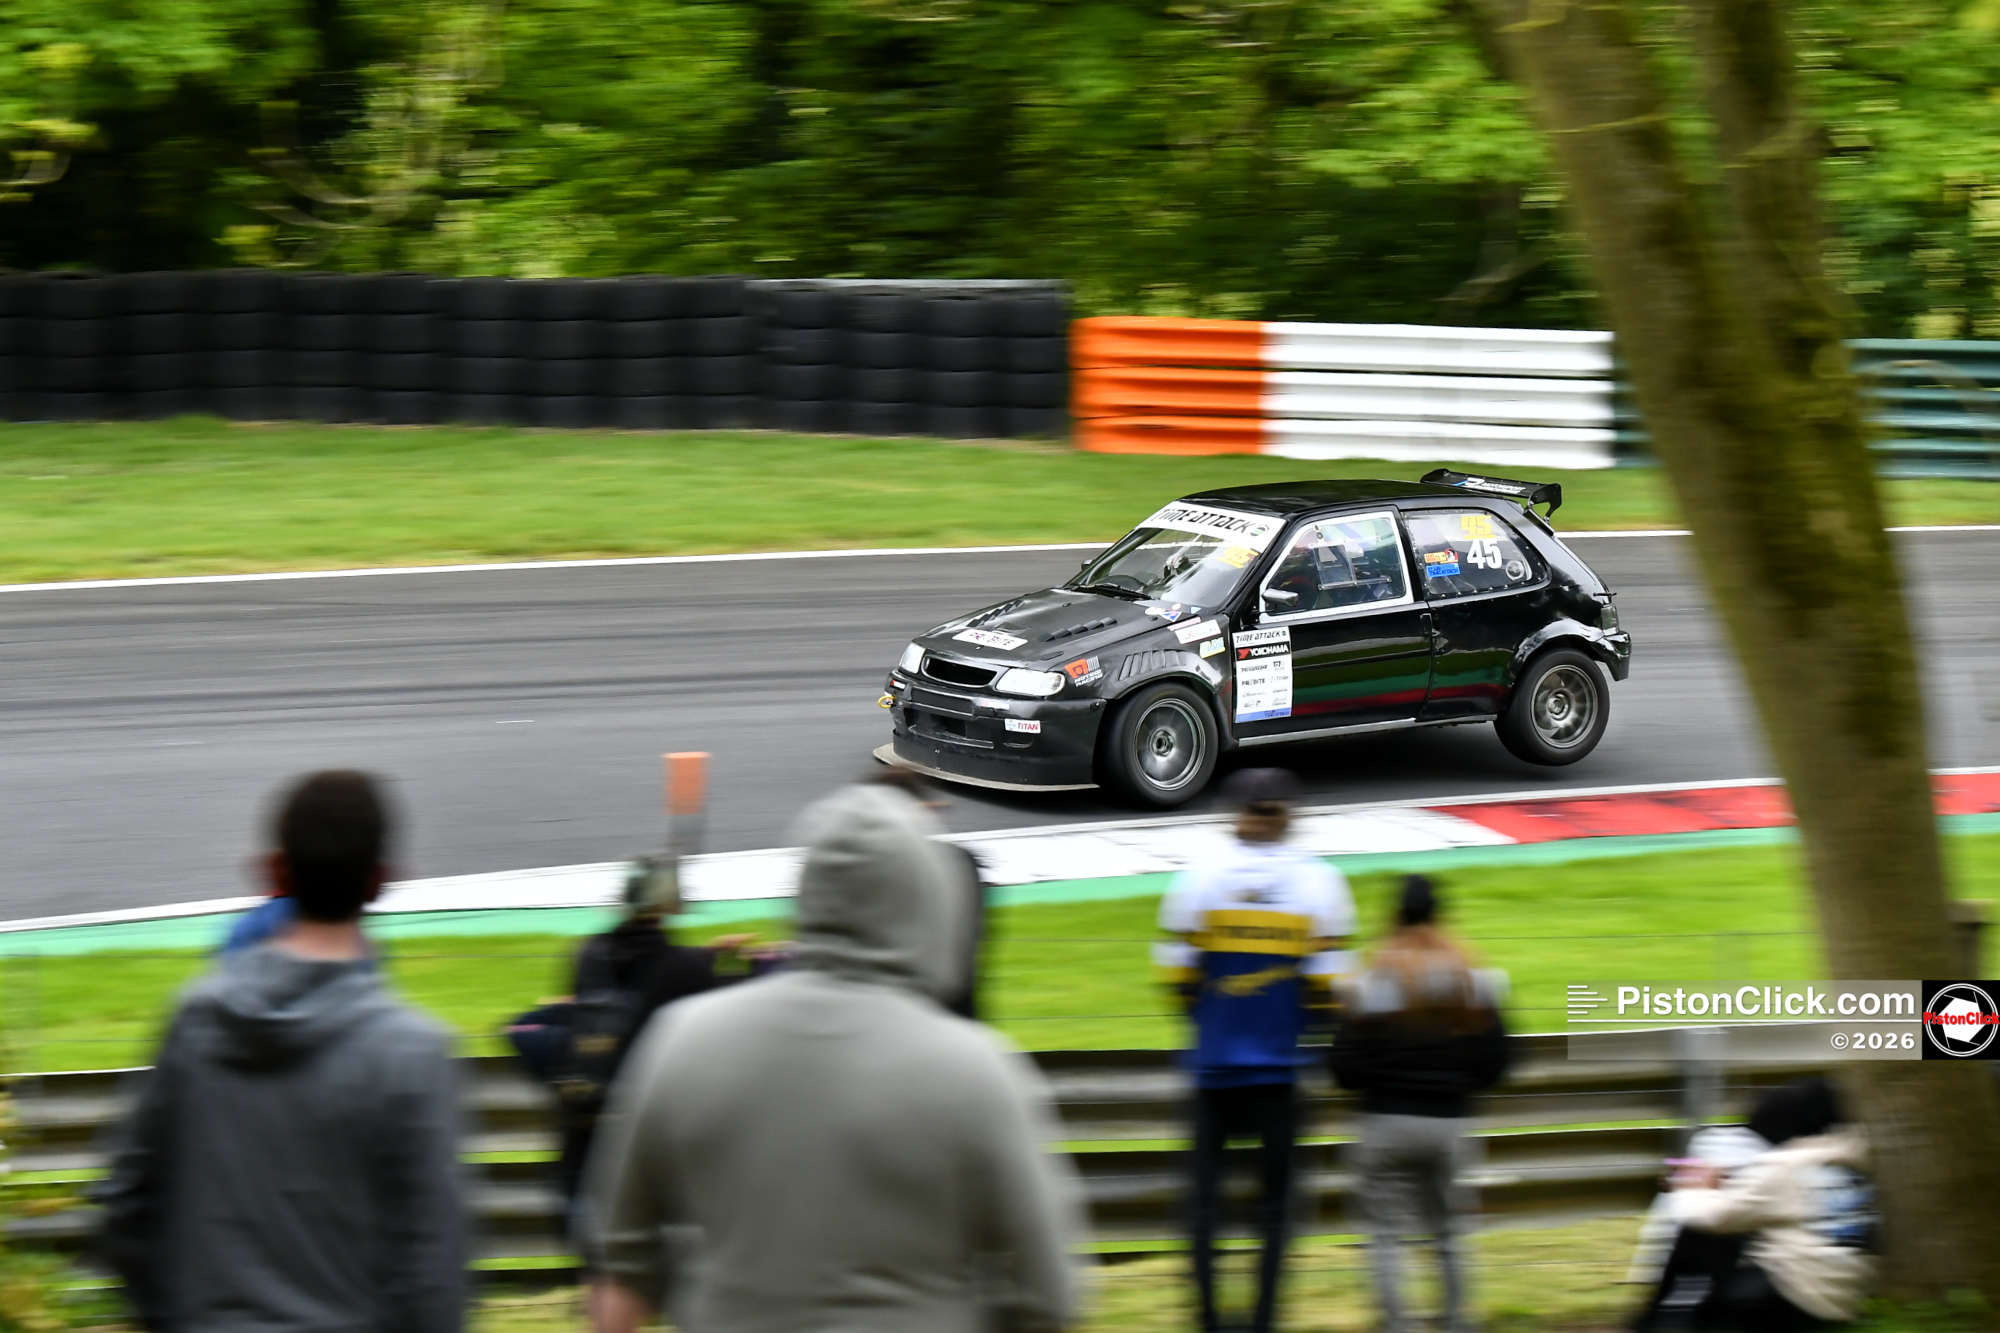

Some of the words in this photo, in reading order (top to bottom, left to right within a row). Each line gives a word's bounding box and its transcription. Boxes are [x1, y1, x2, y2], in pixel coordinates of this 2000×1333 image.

[1187, 512, 1255, 533] ATTACK
[1467, 538, 1503, 569] 45
[1236, 634, 1253, 643] TIME
[1254, 631, 1281, 640] ATTACK
[1249, 644, 1289, 656] YOKOHAMA
[1076, 673, 1103, 687] RACING
[1017, 722, 1039, 731] TITAN
